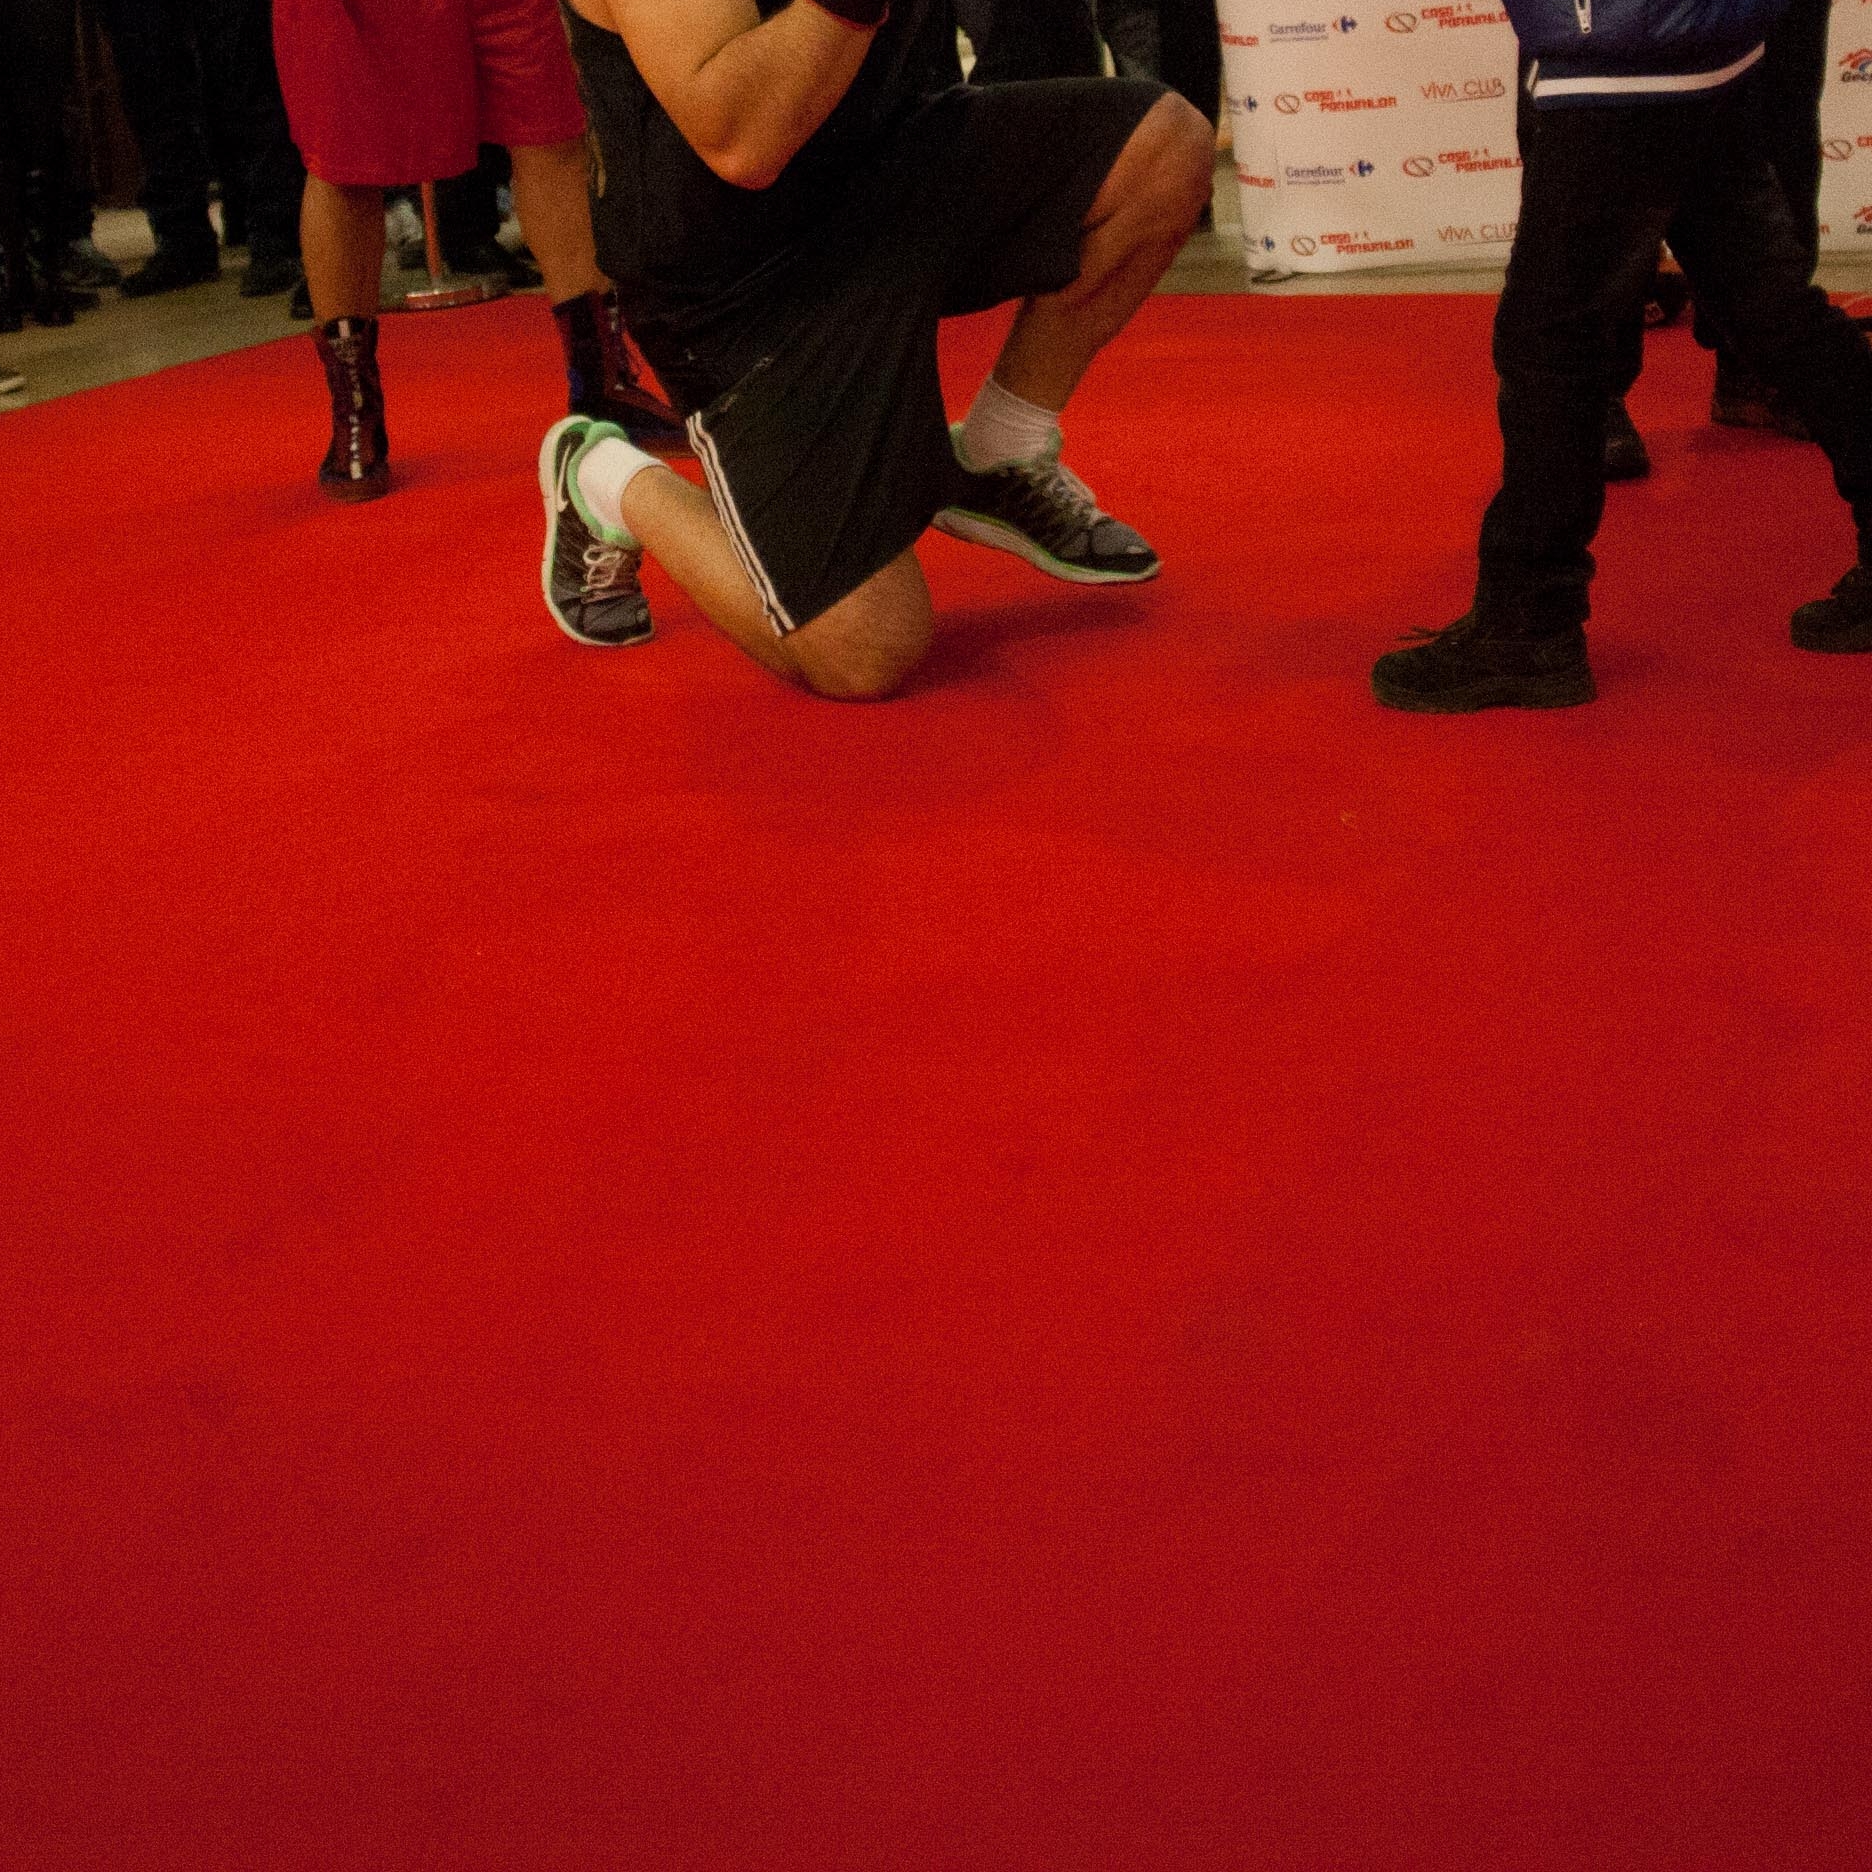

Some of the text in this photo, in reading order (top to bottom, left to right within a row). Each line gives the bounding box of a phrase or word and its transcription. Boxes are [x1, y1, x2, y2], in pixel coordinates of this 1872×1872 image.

[1270, 23, 1326, 34] Carrefour
[1464, 77, 1506, 98] CLUB
[1286, 166, 1343, 178] Carrefour
